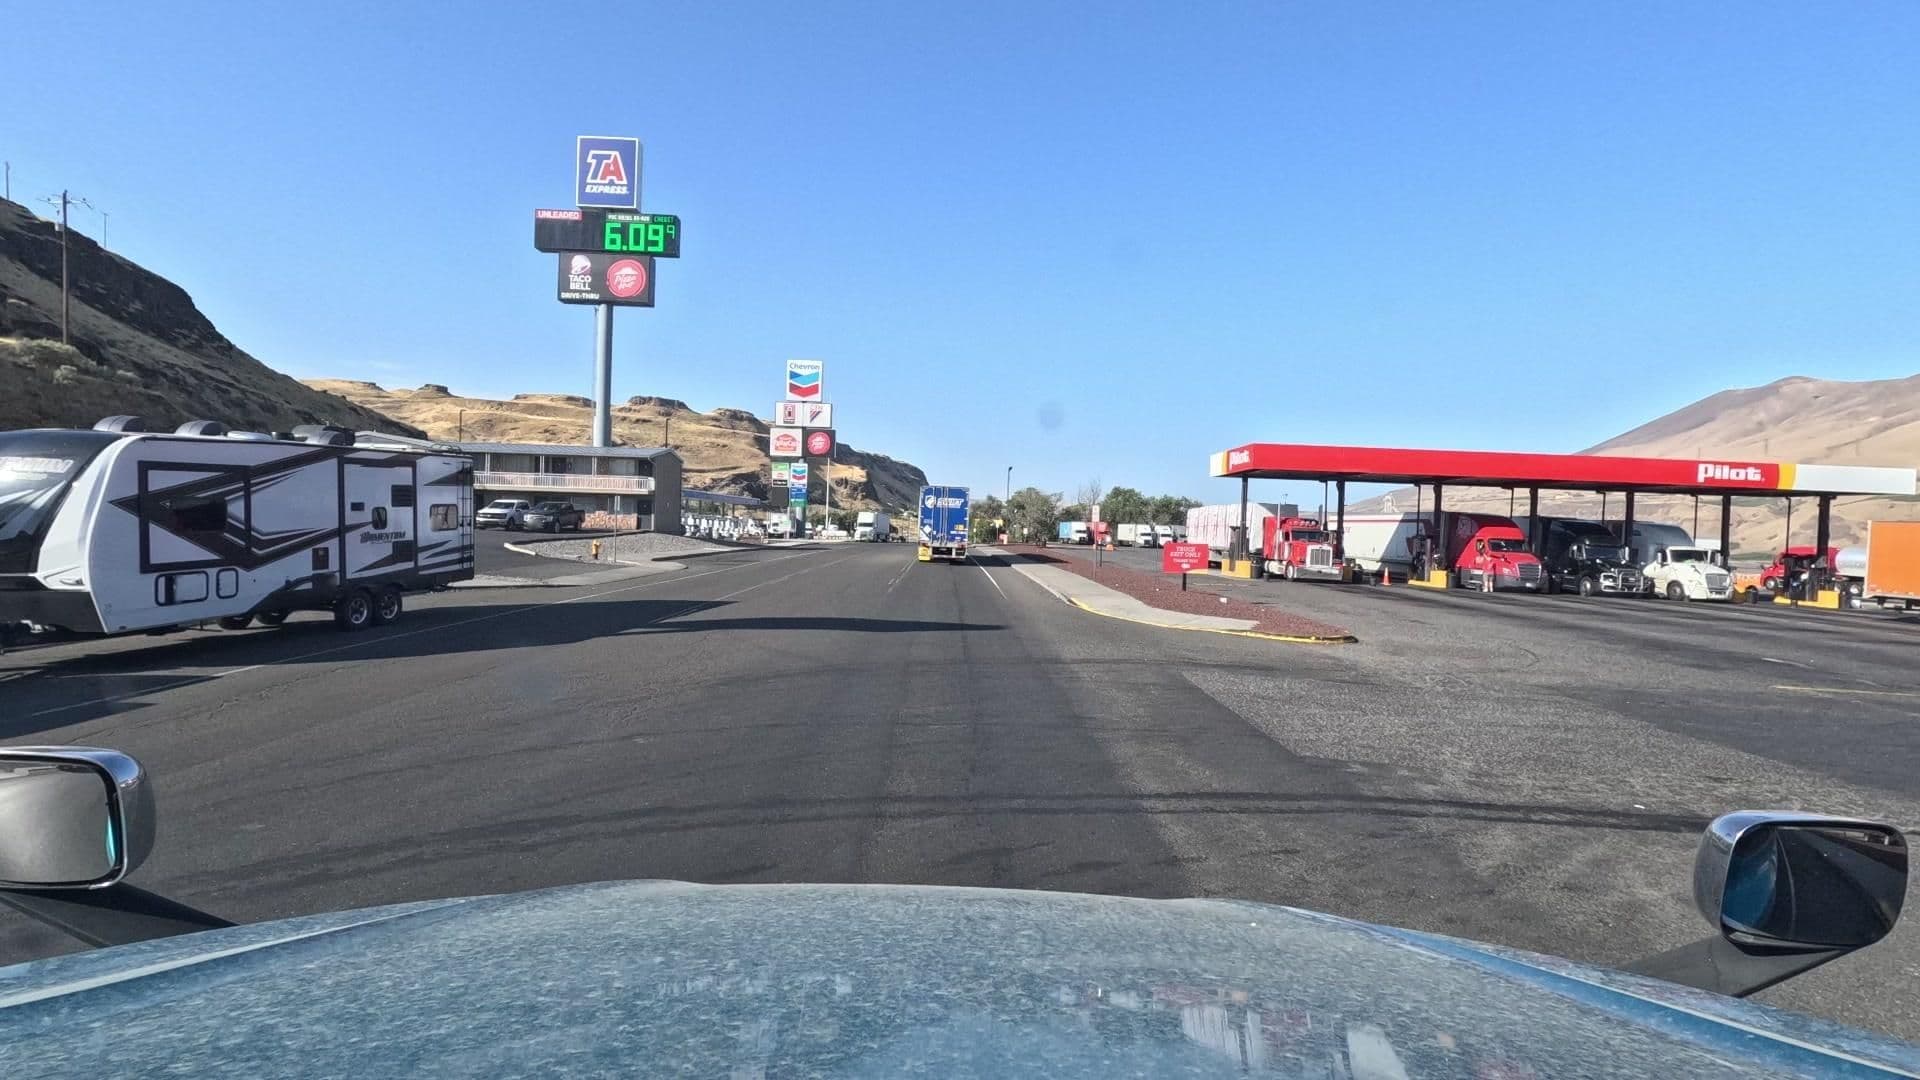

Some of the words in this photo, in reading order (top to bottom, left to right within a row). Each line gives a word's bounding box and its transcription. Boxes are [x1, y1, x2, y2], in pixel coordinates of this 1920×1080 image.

[586, 150, 628, 185] TA
[585, 184, 628, 194] EXPRESS
[538, 210, 579, 220] UNLEADED
[569, 274, 592, 283] TACO
[570, 282, 591, 290] BELL
[561, 292, 600, 300] DRIVE-THRU
[789, 362, 820, 370] Chevron
[1697, 463, 1762, 483] Pilot
